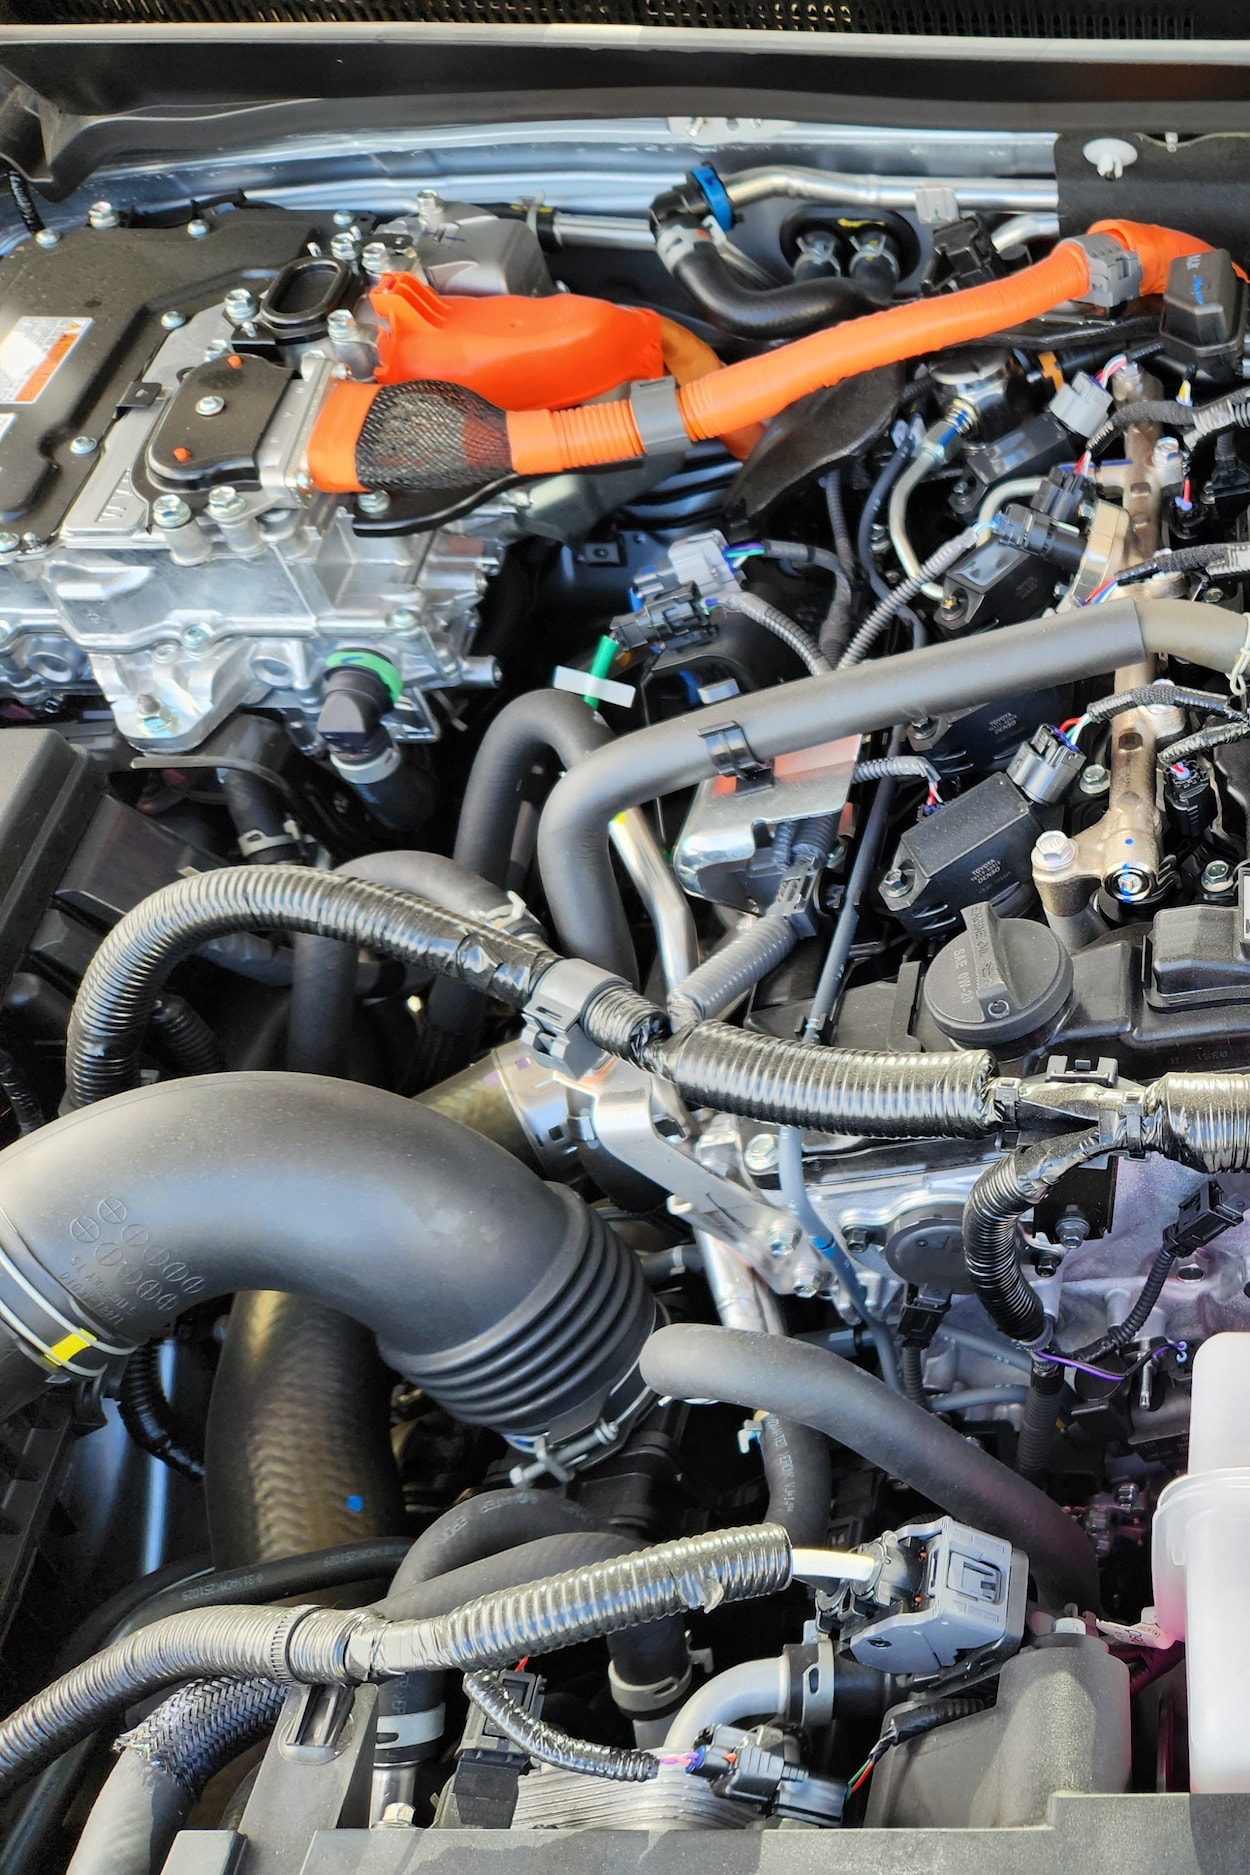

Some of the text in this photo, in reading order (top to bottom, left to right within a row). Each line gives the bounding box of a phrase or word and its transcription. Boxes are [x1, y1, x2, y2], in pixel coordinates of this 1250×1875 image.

[971, 858, 996, 876] TOYOTA
[977, 866, 1001, 884] DENSO
[970, 906, 991, 957] ENGINE OIL
[952, 947, 974, 1005] SAE 0W-20
